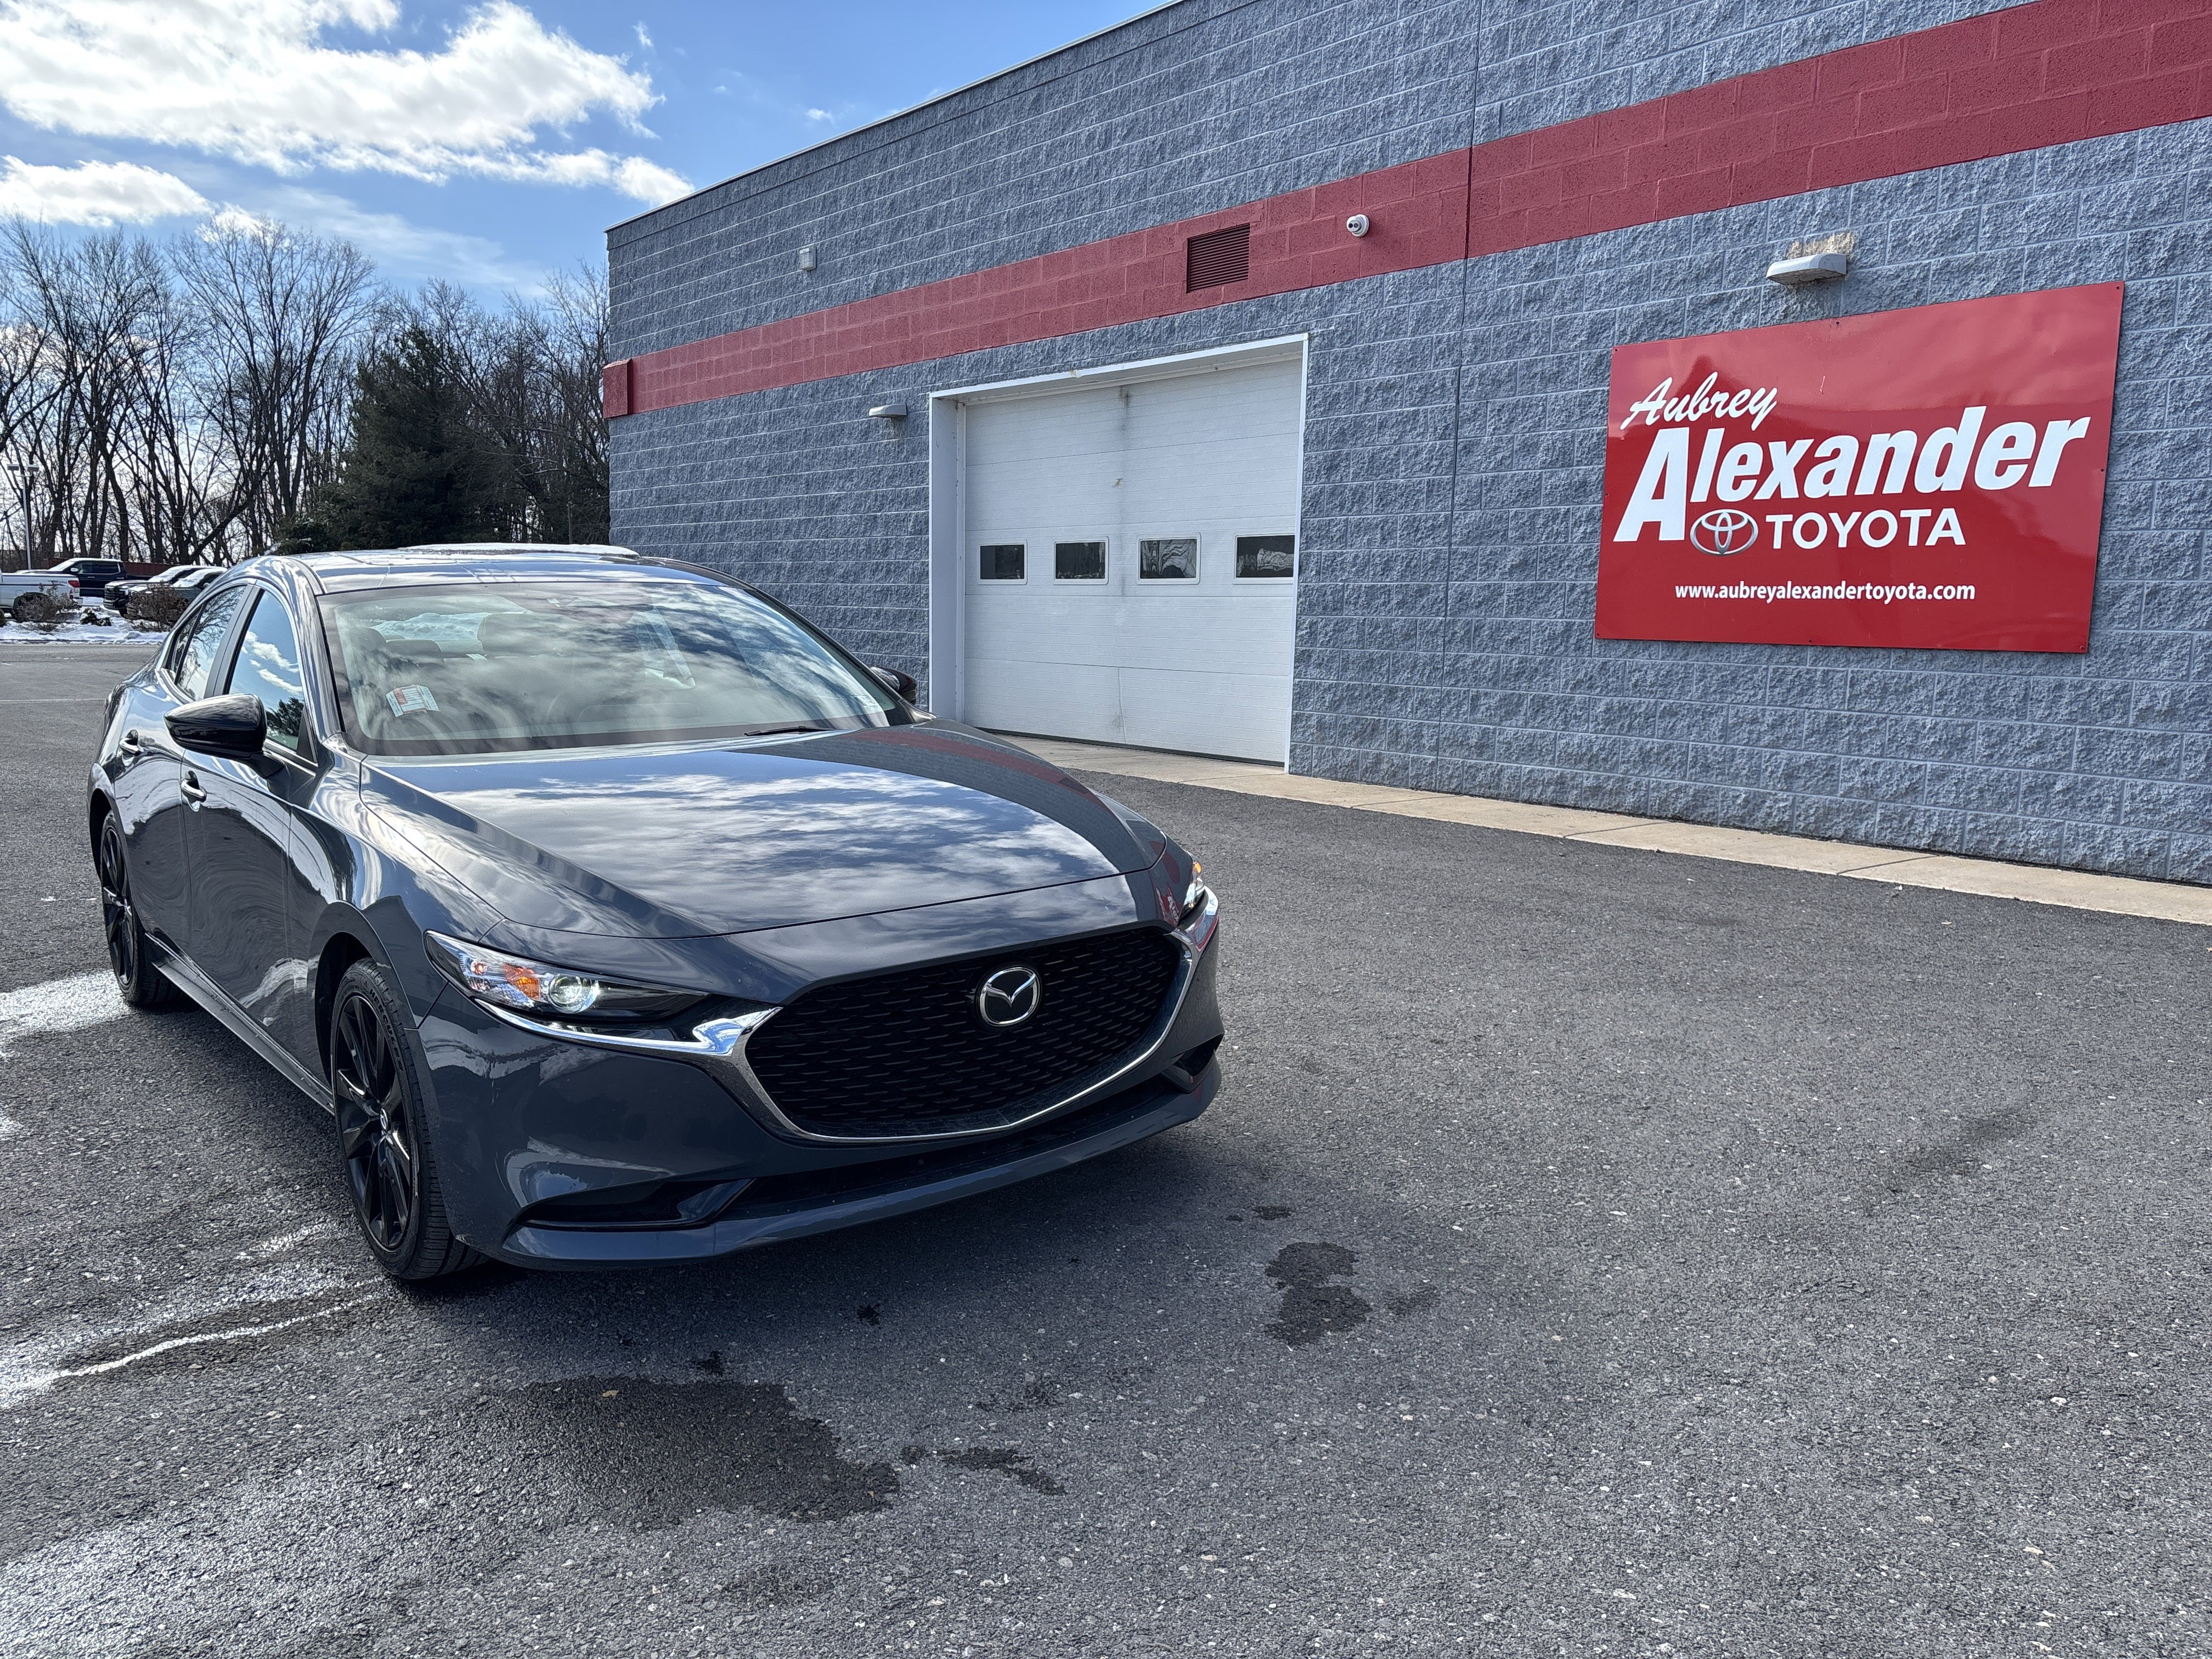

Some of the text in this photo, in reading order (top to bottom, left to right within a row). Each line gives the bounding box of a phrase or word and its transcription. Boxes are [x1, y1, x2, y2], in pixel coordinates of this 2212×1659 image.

[1620, 371, 1778, 431] Aubrey
[1612, 406, 2091, 542] Alexander
[1765, 507, 1966, 549] TOYOTA
[1675, 580, 1976, 604] www.aubreyalexandertoyota.com
